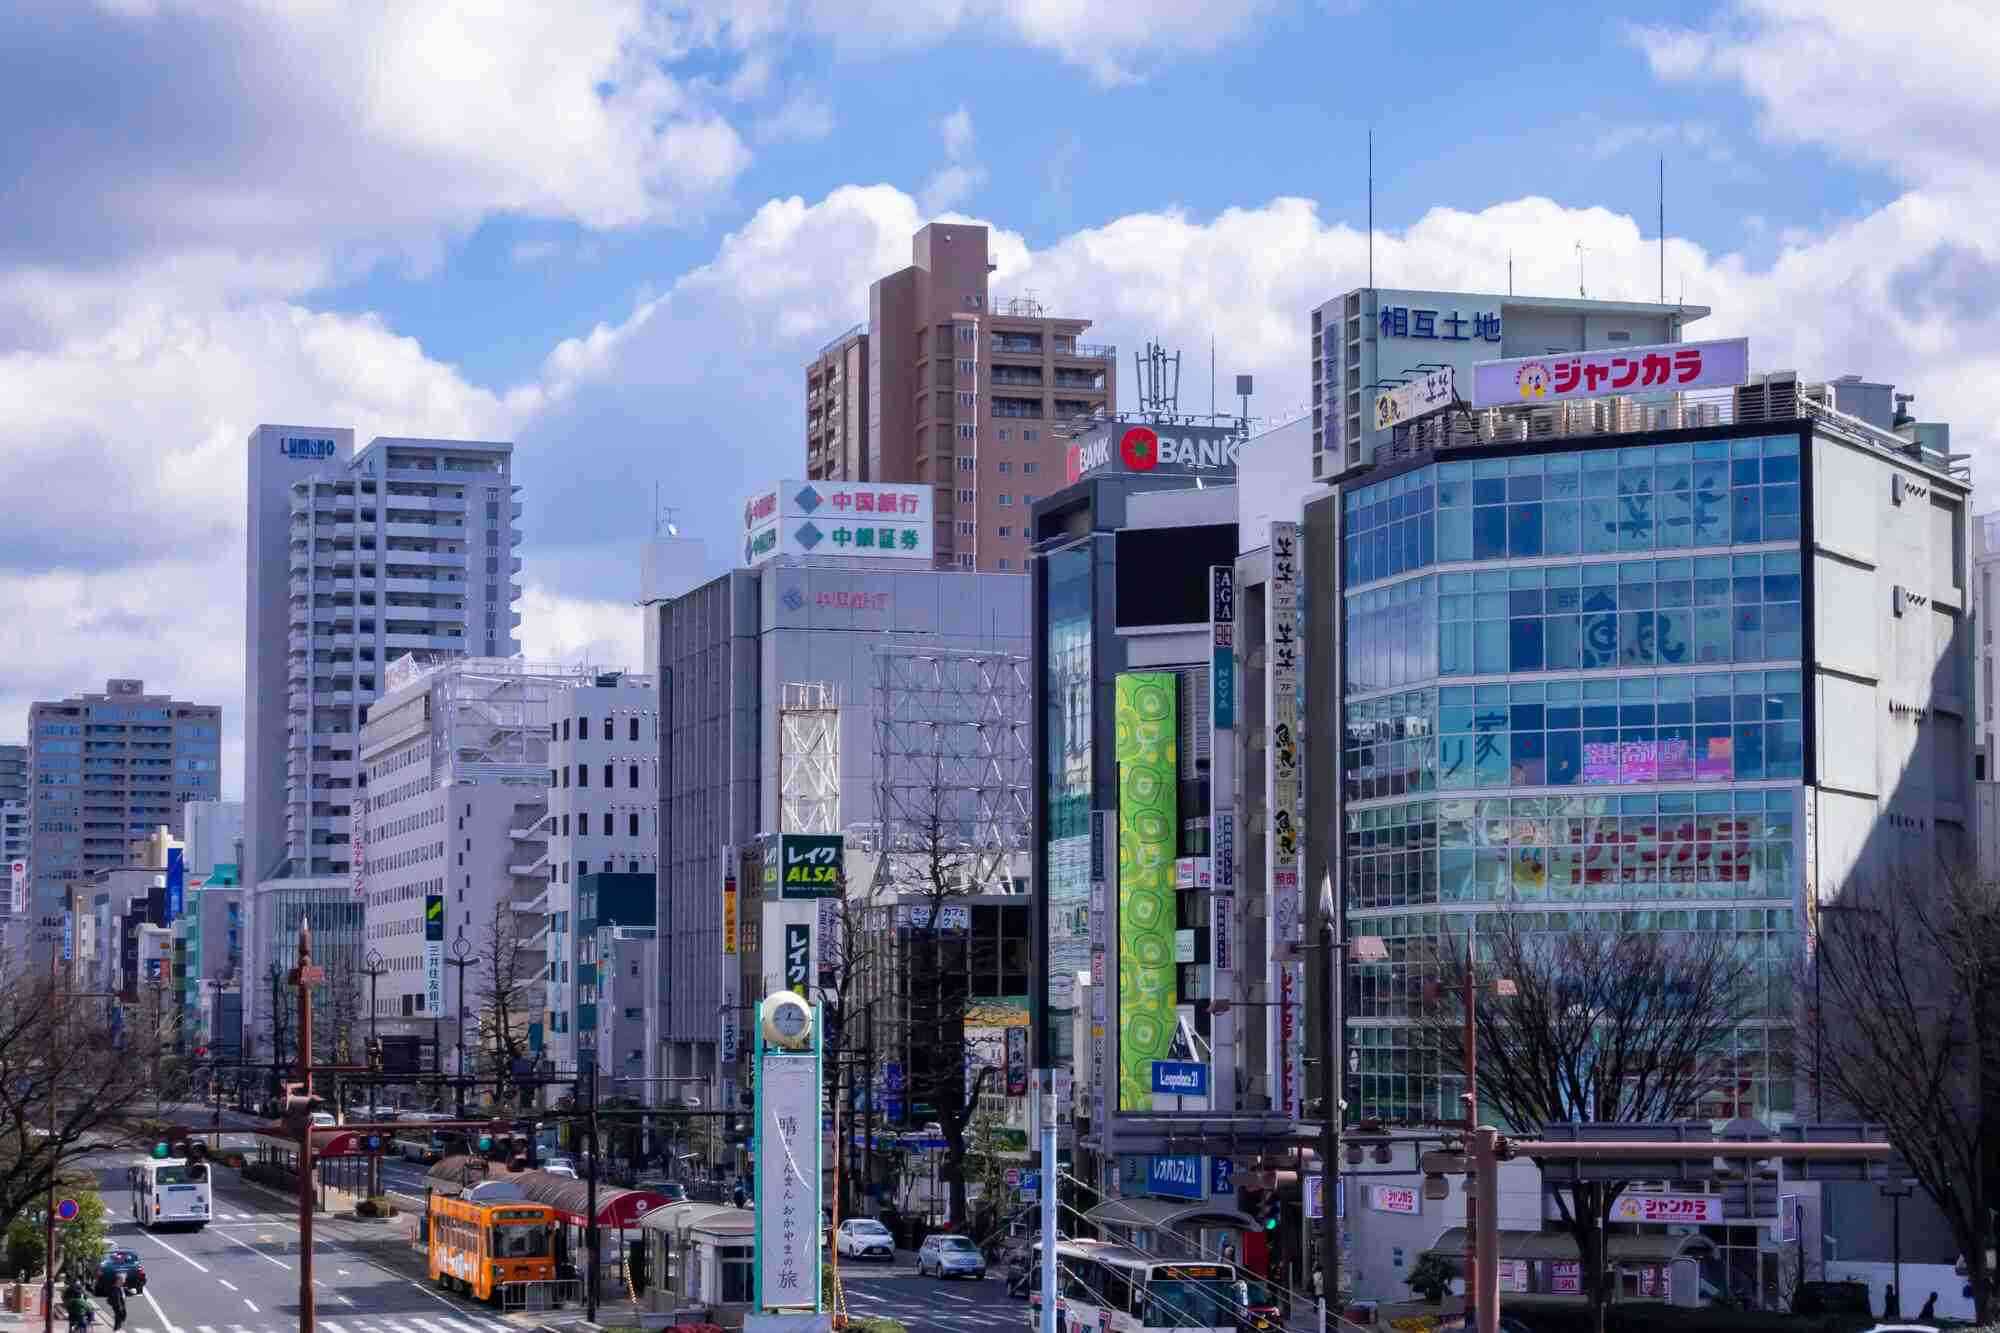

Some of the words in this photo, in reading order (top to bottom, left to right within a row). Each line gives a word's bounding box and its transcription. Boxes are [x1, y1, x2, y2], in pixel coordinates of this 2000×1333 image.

[1380, 305, 1502, 343] 相互土地
[1553, 350, 1705, 394] ジャンカラ
[1081, 437, 1110, 472] BANK
[1157, 437, 1240, 466] BANK
[831, 490, 920, 514] 中国銀行
[831, 526, 920, 550] 中銀証券
[1220, 571, 1232, 619] AGA
[1218, 668, 1229, 710] NOVA
[787, 846, 837, 864] レイク
[786, 866, 838, 882] ALSA
[787, 930, 807, 982] レイク
[1645, 1198, 1707, 1214] ジャンカラ
